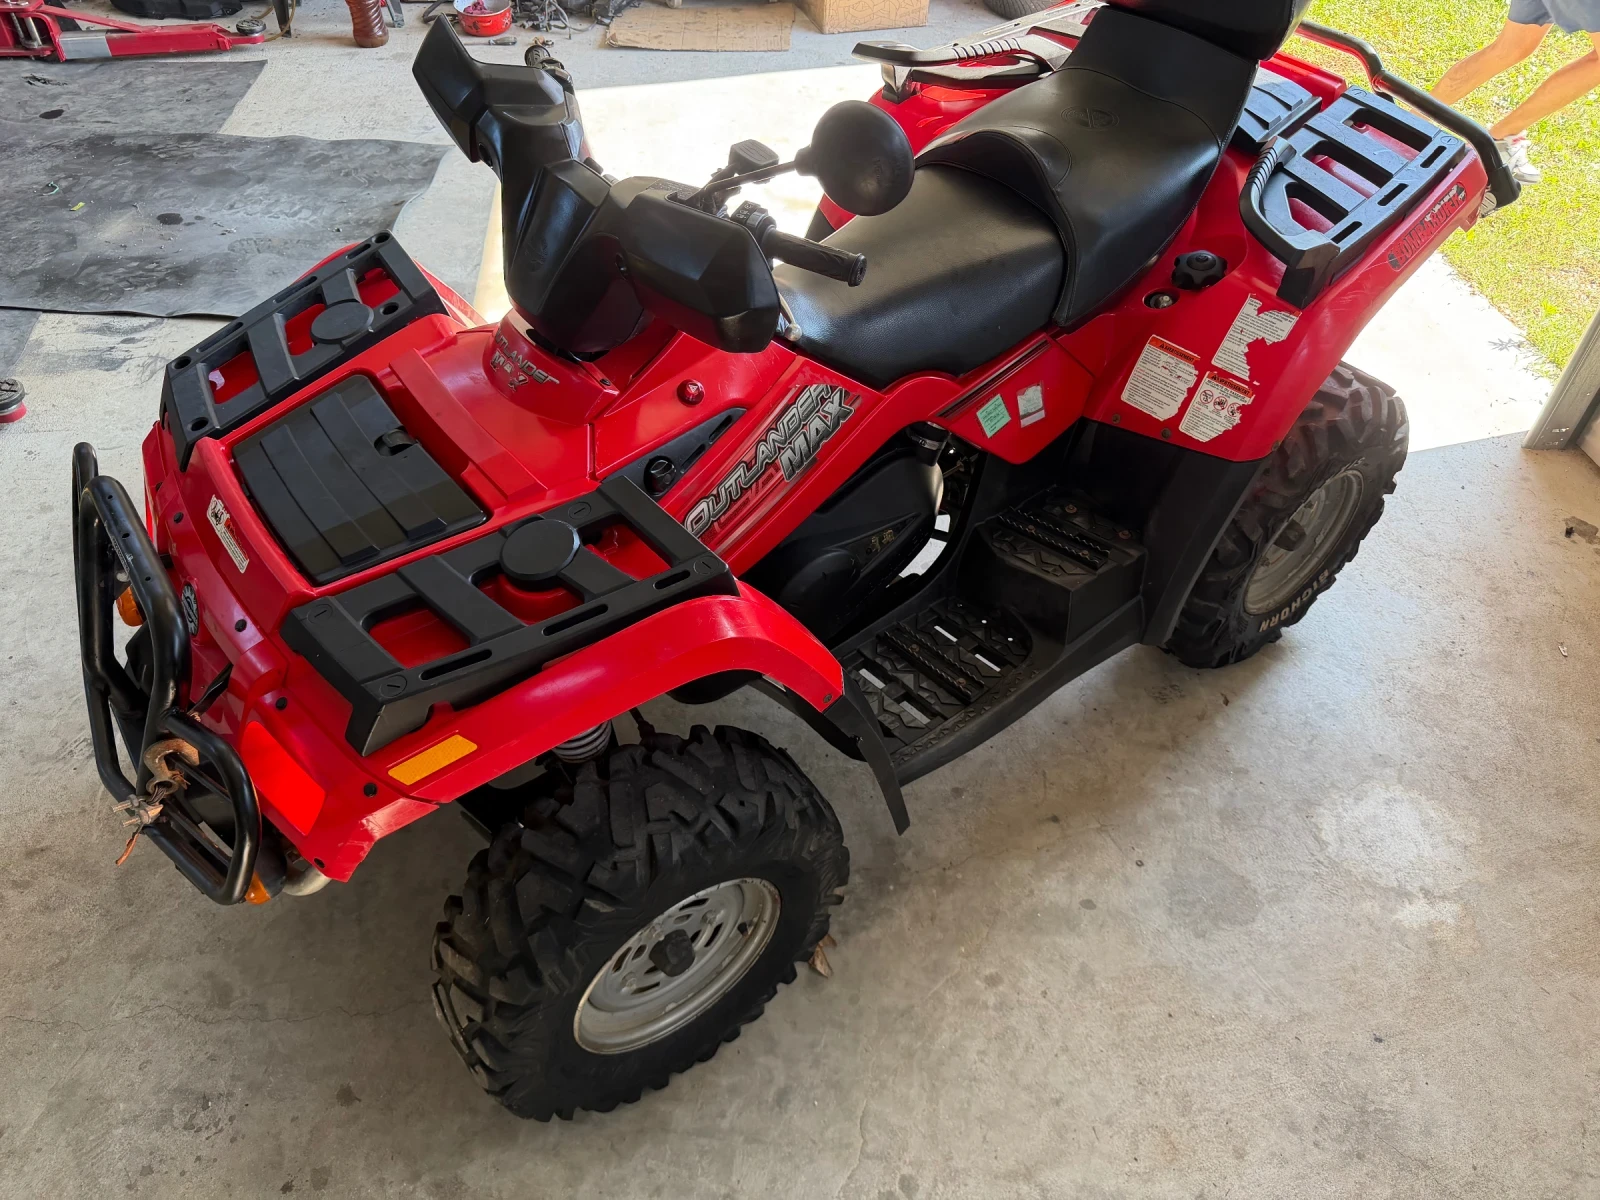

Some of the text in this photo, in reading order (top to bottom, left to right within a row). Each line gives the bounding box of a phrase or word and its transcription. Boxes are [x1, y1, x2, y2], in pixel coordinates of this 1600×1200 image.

[684, 384, 831, 538] OUTLANDER
[778, 386, 854, 482] MAX
[1259, 569, 1329, 632] BIGHORN
